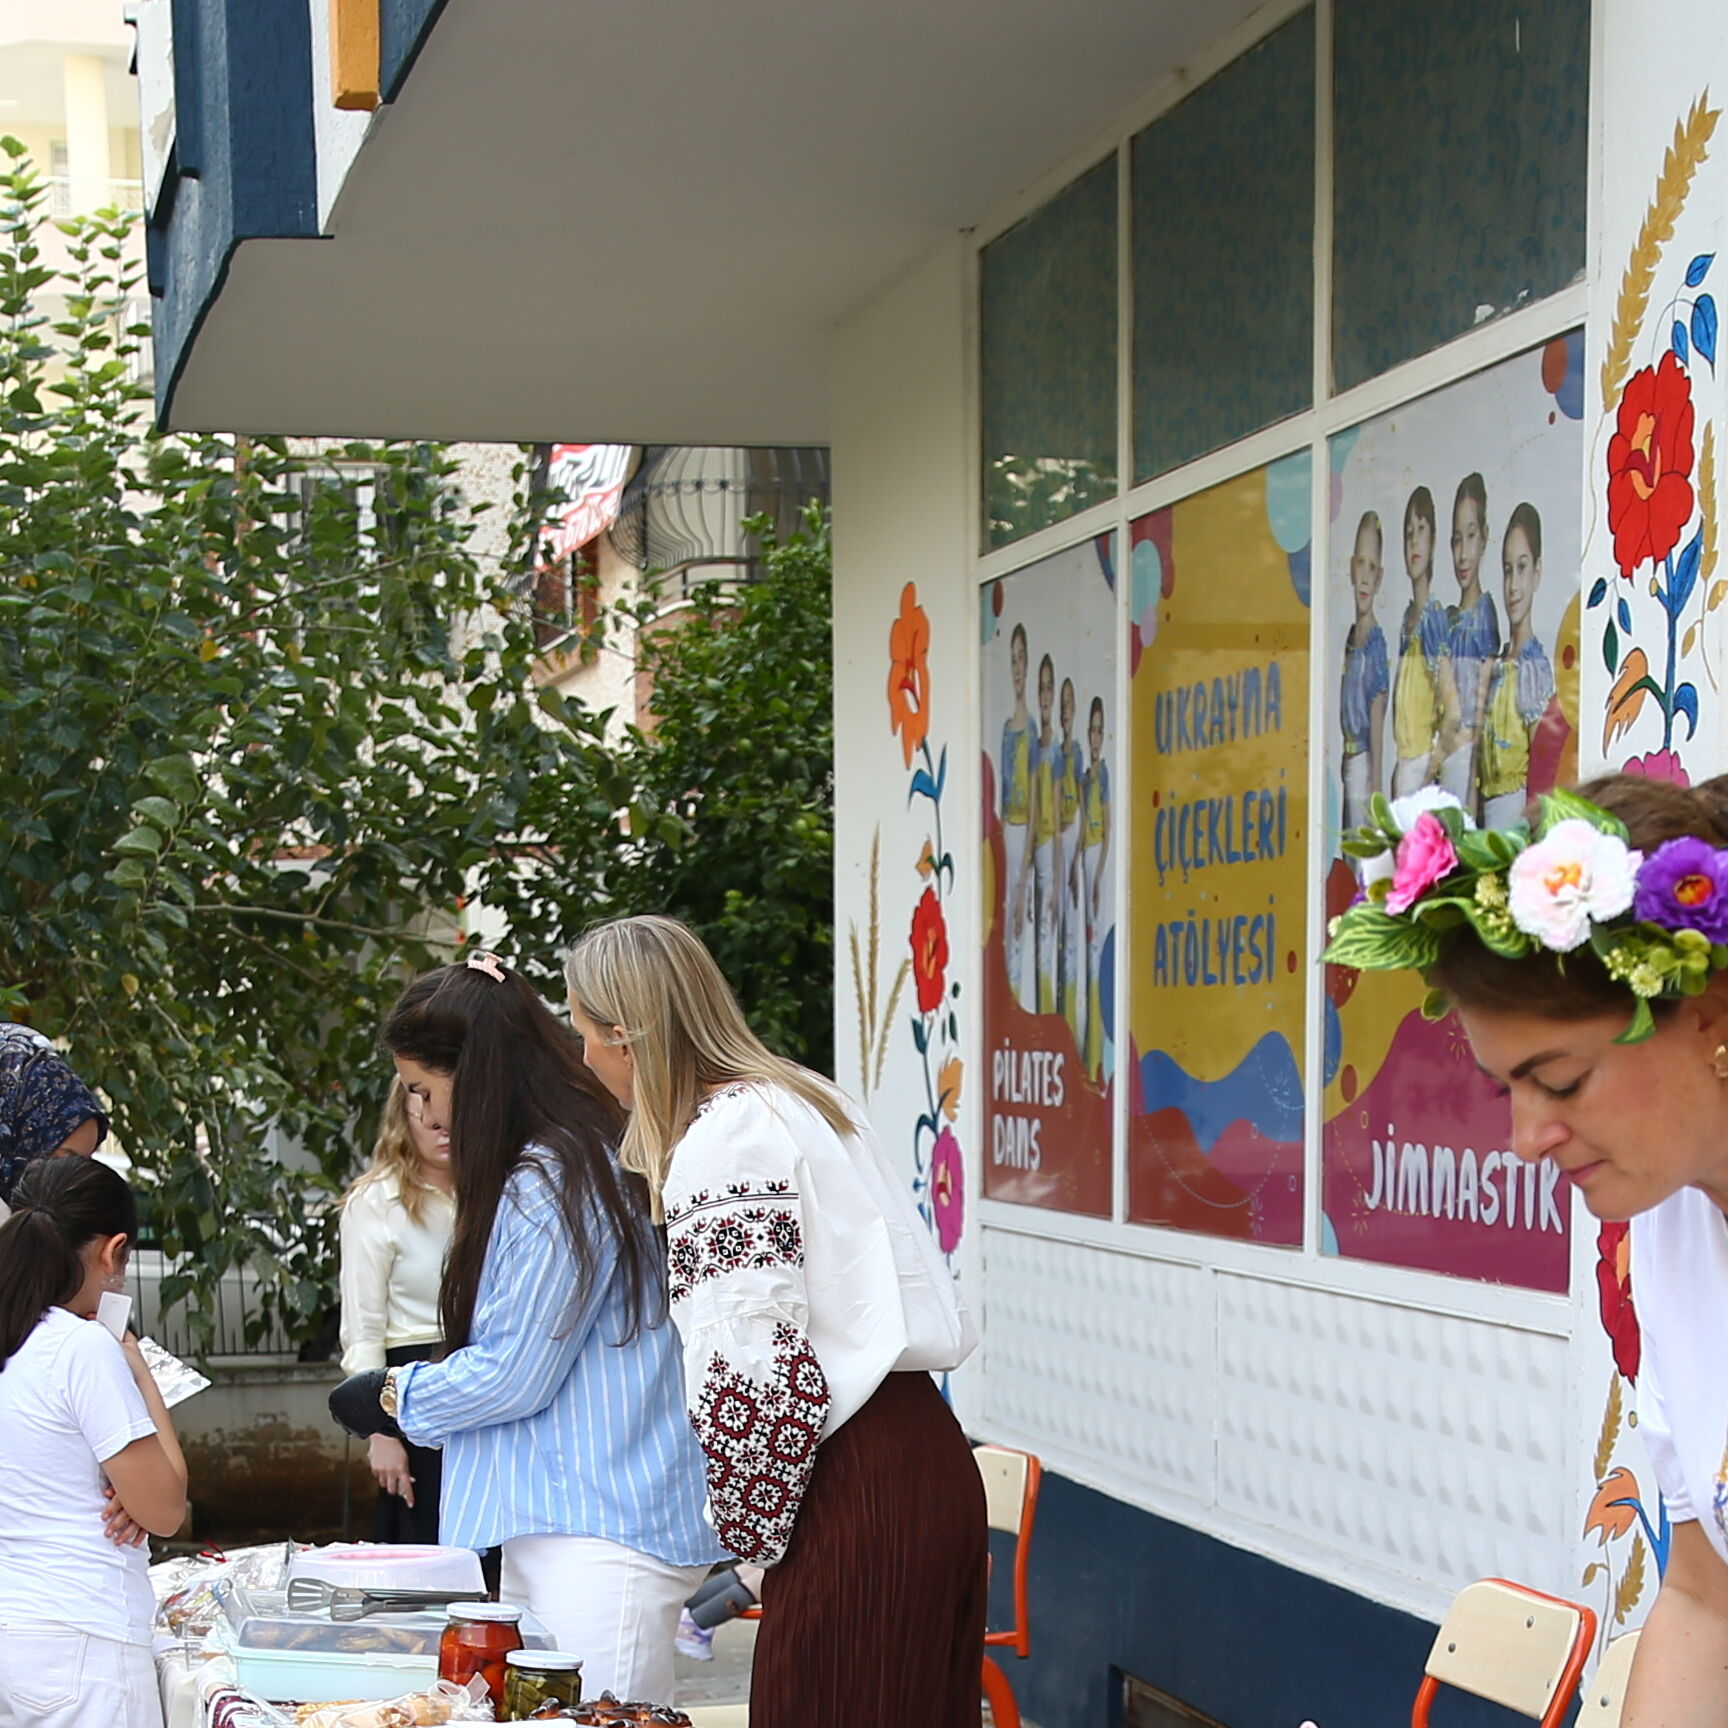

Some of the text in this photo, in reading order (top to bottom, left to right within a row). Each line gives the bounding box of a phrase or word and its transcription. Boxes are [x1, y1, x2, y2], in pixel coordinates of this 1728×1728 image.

[1155, 660, 1282, 755] UKRAYNA
[1154, 768, 1286, 887] ÇİÇEKLERİ
[1154, 894, 1275, 987] ATÖLYESİ
[993, 1038, 1065, 1107] PİLATES
[993, 1114, 1041, 1171] DANS
